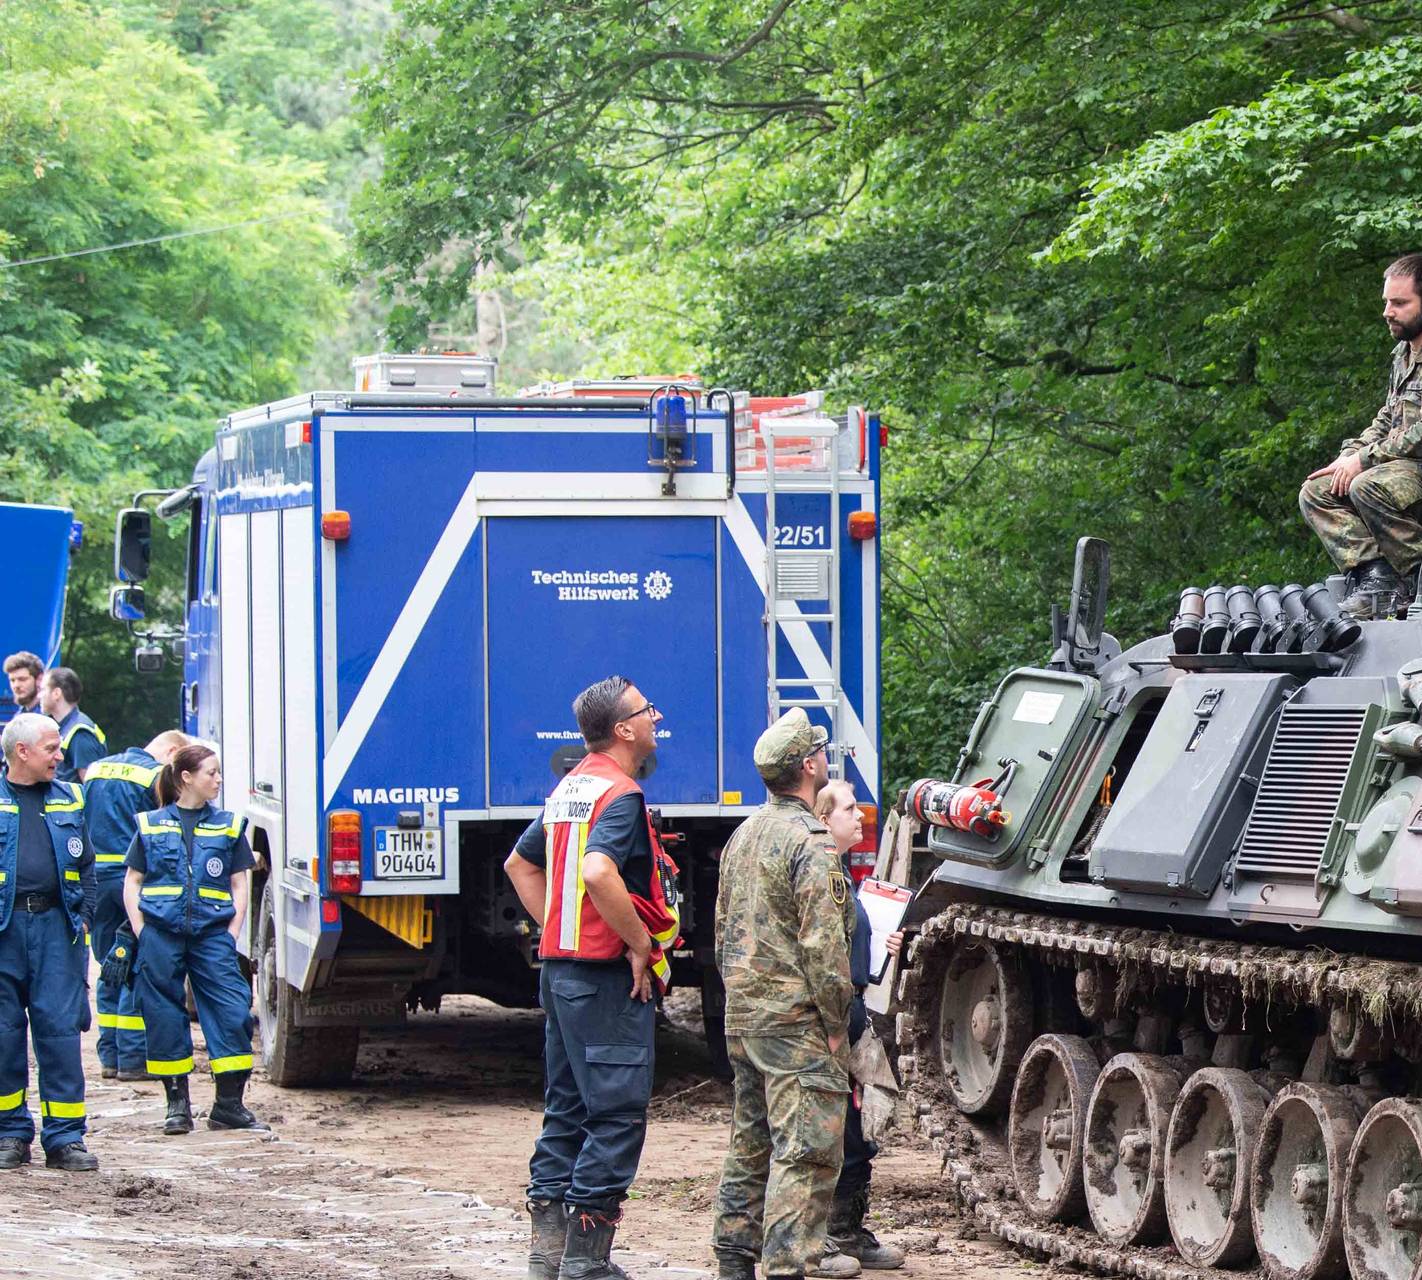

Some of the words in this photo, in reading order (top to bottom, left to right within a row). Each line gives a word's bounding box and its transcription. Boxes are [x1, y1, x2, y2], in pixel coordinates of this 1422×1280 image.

[774, 526, 824, 545] 22/51
[531, 570, 638, 584] Technisches
[558, 587, 639, 600] Hilfswerk
[353, 787, 460, 804] MAGIRUS
[390, 832, 423, 852] THW
[382, 854, 436, 873] 90404
